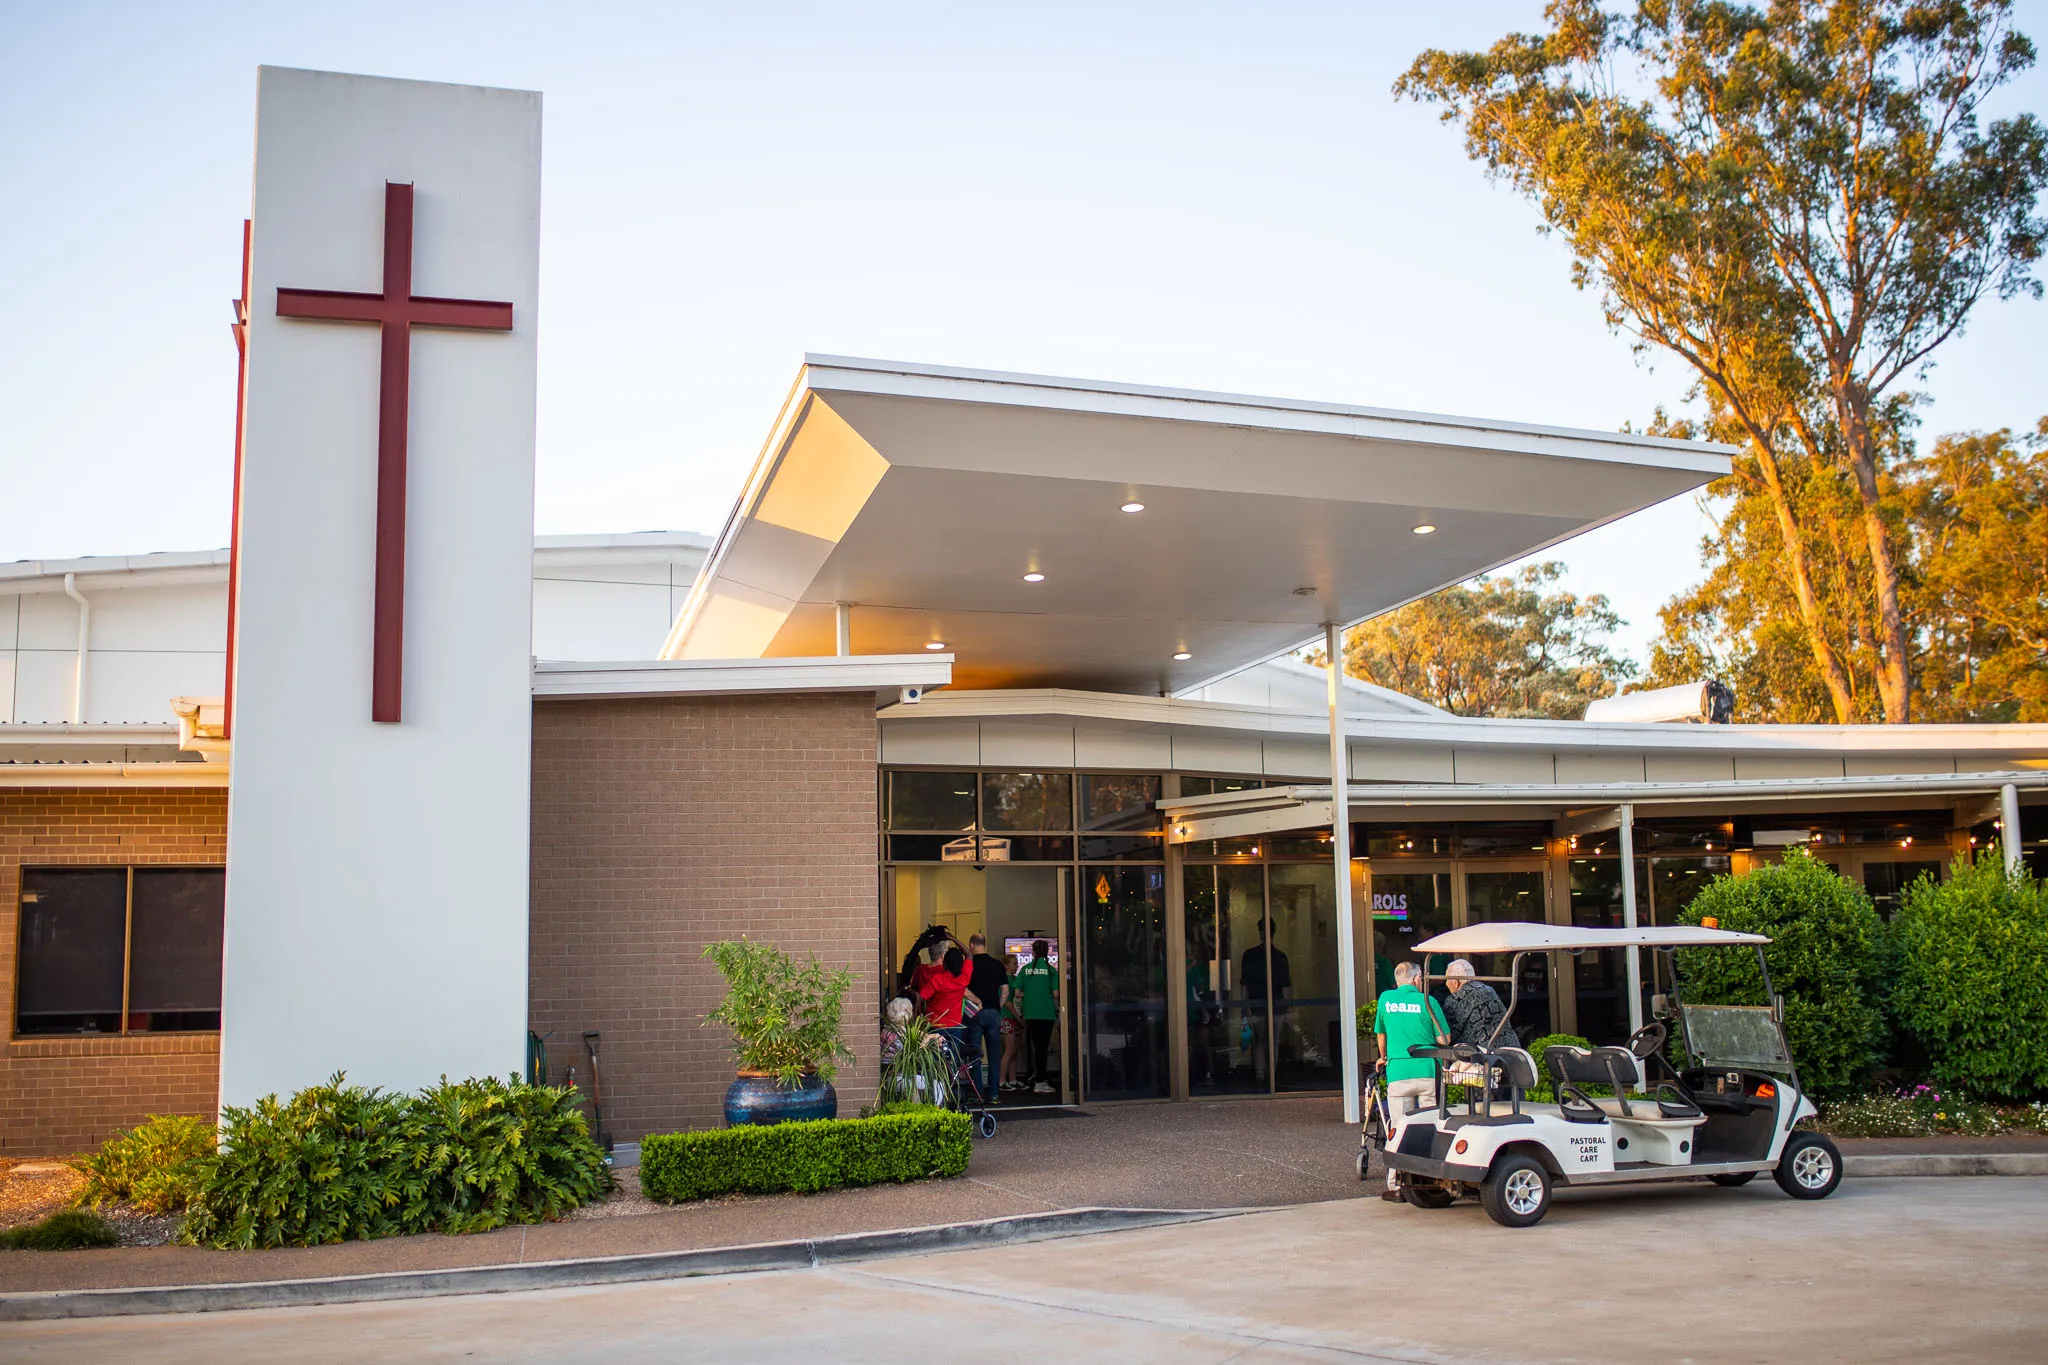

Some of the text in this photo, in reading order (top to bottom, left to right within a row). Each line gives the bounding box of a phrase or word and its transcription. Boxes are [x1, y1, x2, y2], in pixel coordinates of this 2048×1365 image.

[1372, 893, 1407, 910] ROLS
[1025, 967, 1048, 975] team
[1385, 1001, 1421, 1013] team
[1570, 1137, 1606, 1145] PASTORAL
[1580, 1146, 1598, 1154] CARE
[1580, 1154, 1598, 1162] CART
